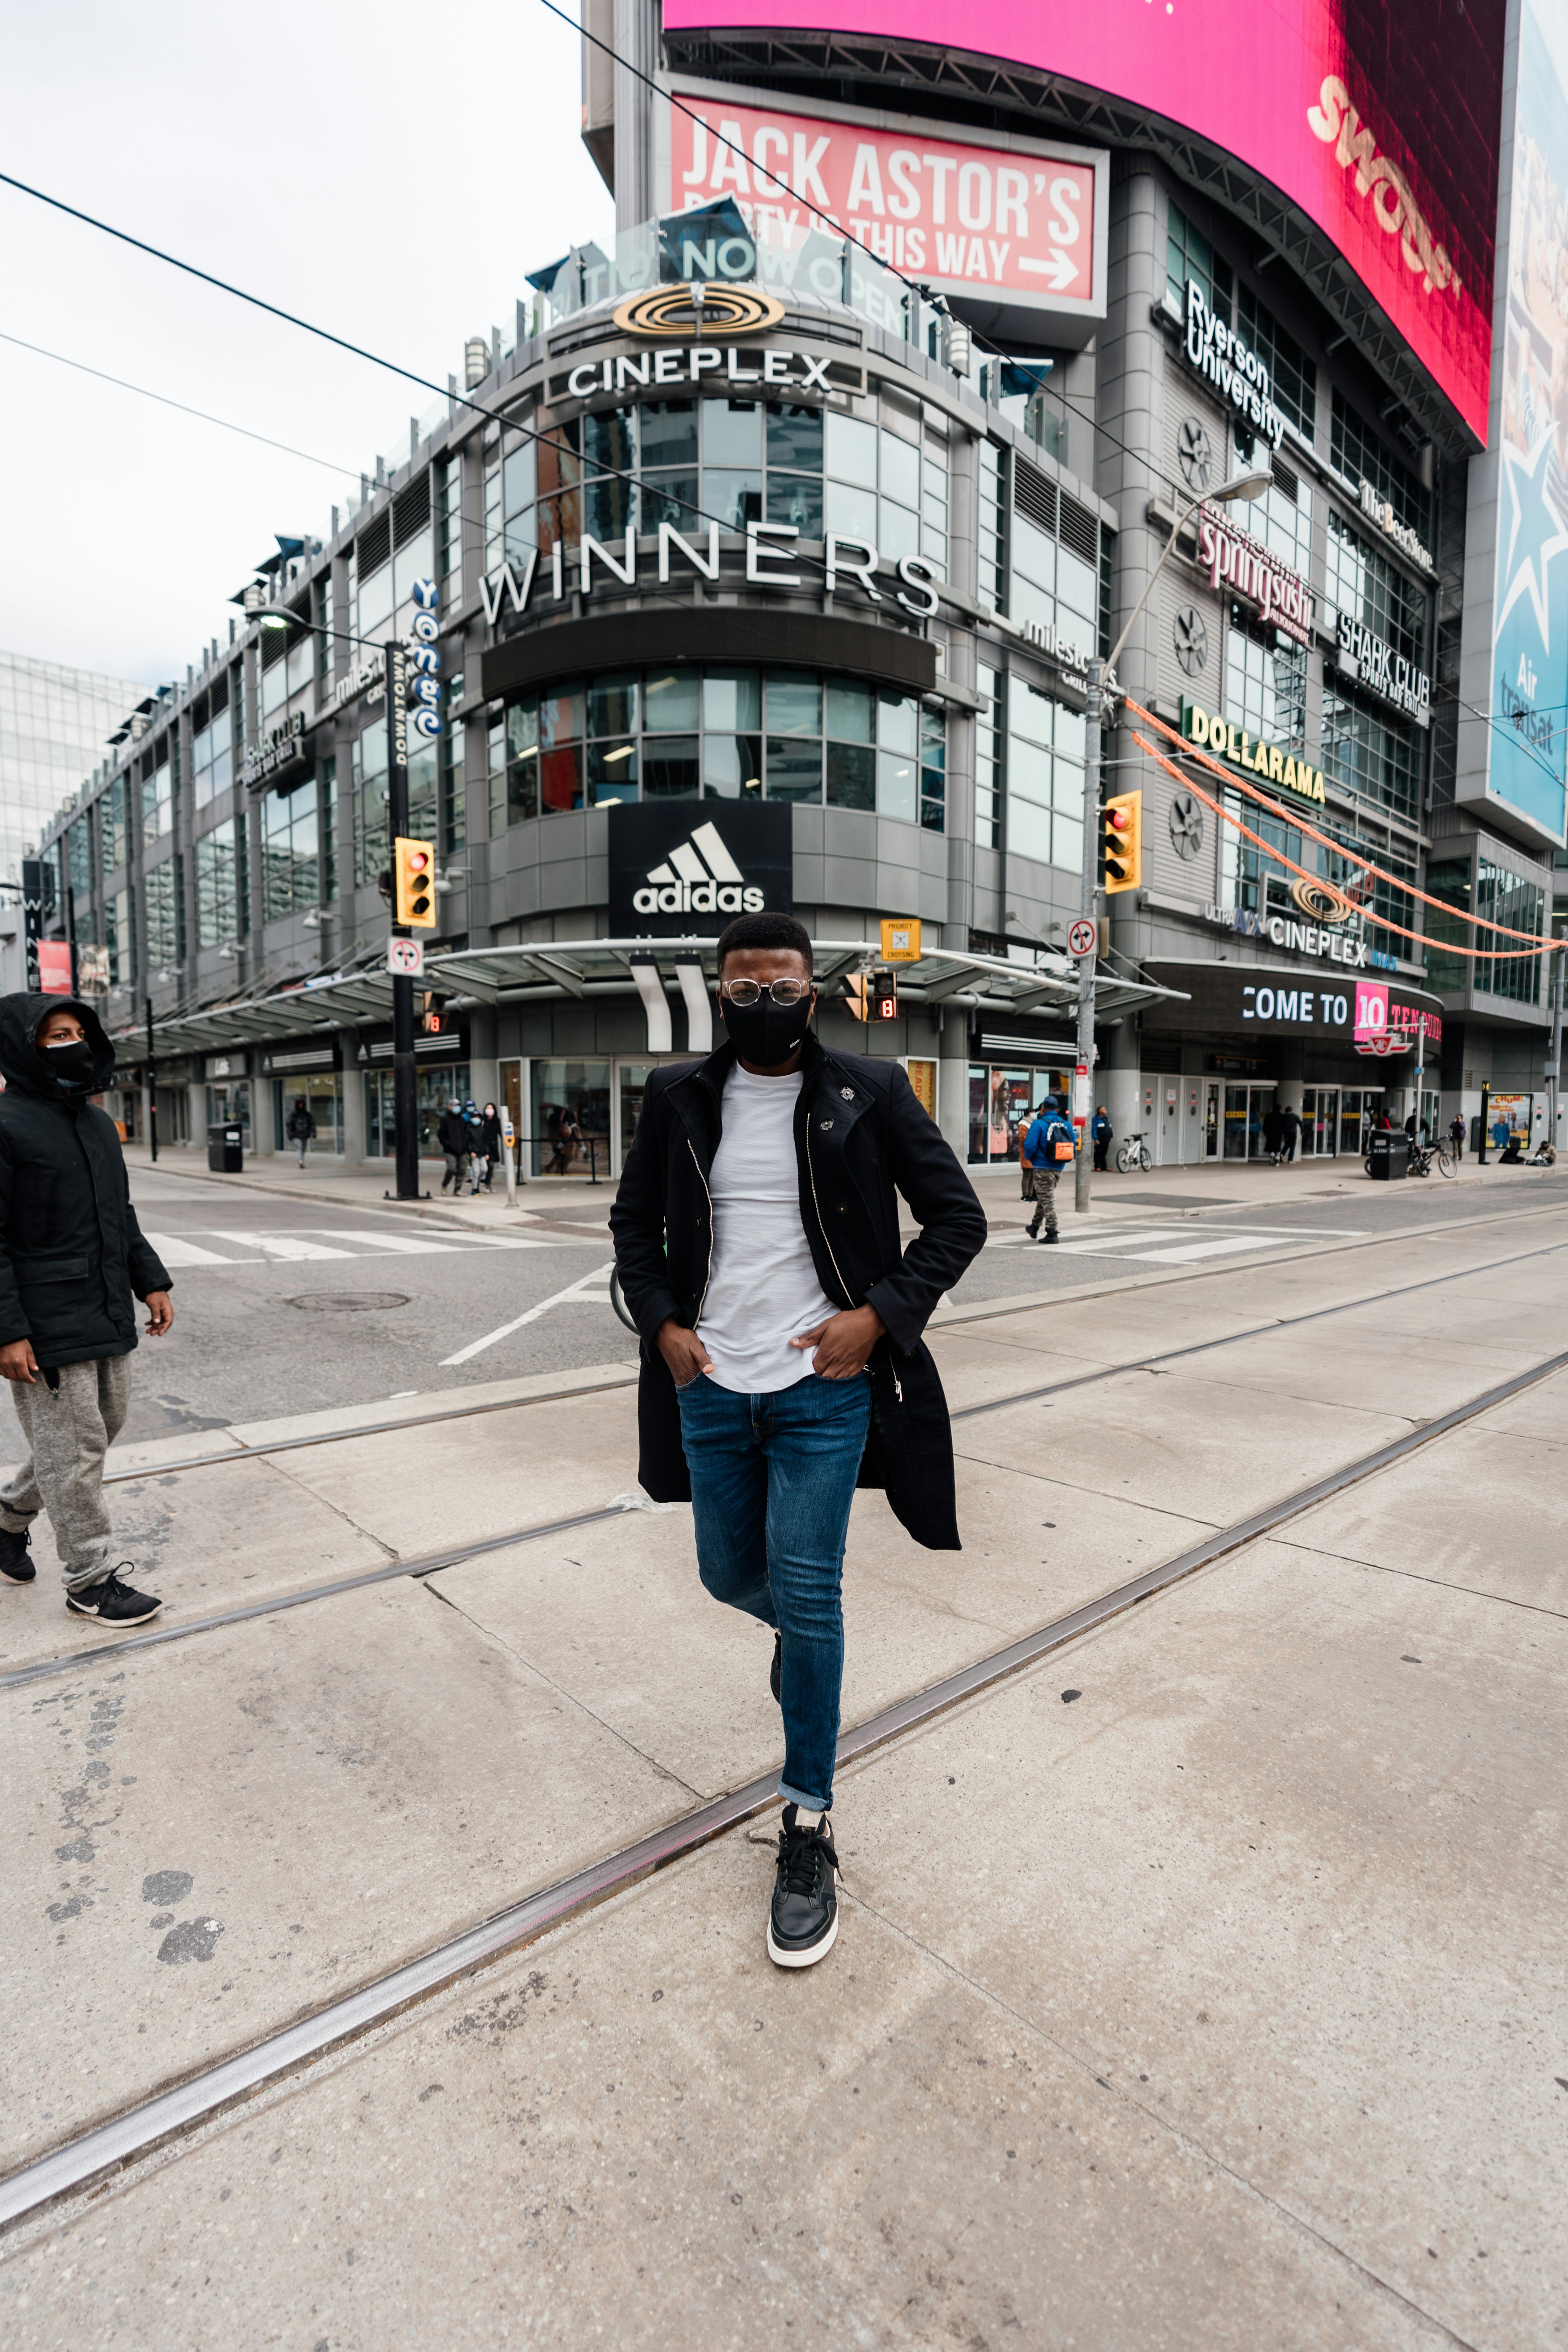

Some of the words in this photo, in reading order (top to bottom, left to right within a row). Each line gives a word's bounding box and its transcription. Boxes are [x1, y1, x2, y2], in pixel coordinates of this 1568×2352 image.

[683, 114, 831, 208] JACK
[846, 142, 1081, 246] ASTOR'S
[683, 238, 803, 286] NOW
[849, 218, 926, 270] THIS
[935, 231, 1010, 281] WAY
[568, 347, 833, 397] CINEPLEX
[1188, 278, 1268, 396] Ryerson
[1187, 318, 1285, 451] University
[478, 520, 939, 626] WINNERS
[1340, 613, 1391, 683] SHARK
[1396, 656, 1429, 708] CLUB
[1361, 662, 1387, 693] SPORTS
[1389, 682, 1402, 704] BAR
[1404, 693, 1420, 717] GRILL
[1518, 652, 1537, 700] Air
[393, 651, 408, 766] DOWNTOWN
[1502, 671, 1554, 755] transat
[1192, 705, 1325, 803] DOLLARAMA
[633, 879, 765, 914] adidas
[1269, 917, 1367, 968] CINEPLEX
[1372, 950, 1399, 972] IMAX
[1320, 994, 1348, 1025] TO
[1358, 995, 1385, 1031] 10
[1391, 1005, 1420, 1035] TEN
